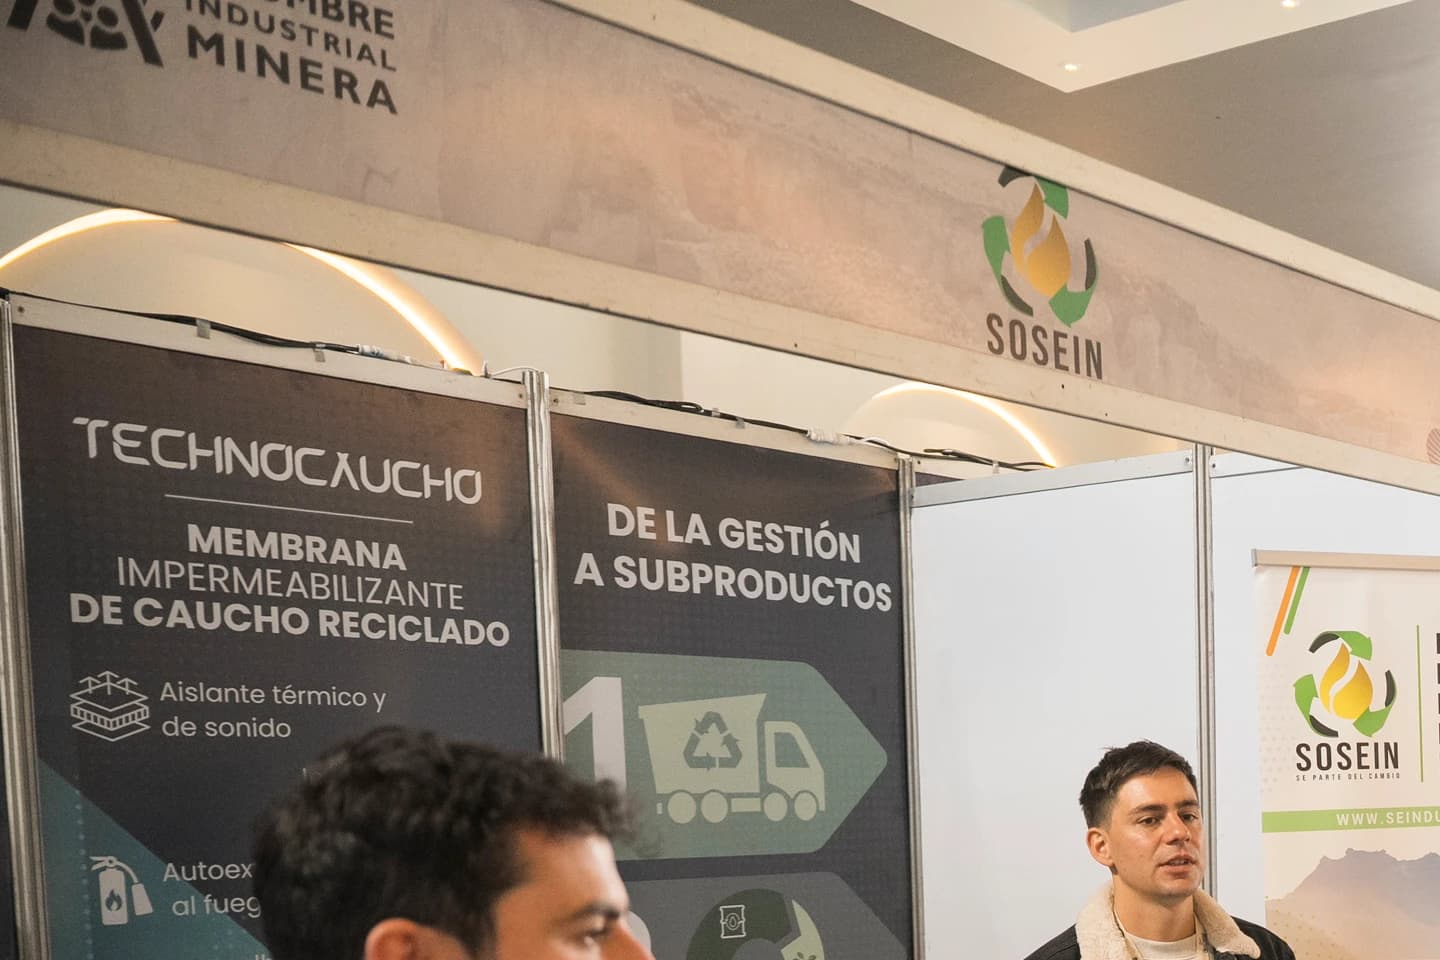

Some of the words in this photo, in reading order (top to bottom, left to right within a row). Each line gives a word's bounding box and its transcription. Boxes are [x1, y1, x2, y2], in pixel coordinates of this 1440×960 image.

[187, 24, 398, 115] MINERA
[986, 312, 1103, 380] SOSEIN
[72, 416, 483, 505] TECHNOCAUCHO
[187, 523, 407, 571] MEMBRANA
[606, 502, 657, 540] DE
[665, 509, 712, 547] LA
[718, 516, 861, 564] GESTIÓN
[117, 556, 465, 611] IMPERMEABILIZANTE
[573, 552, 605, 588] A
[613, 555, 893, 612] SUBPRODUCTOS
[69, 592, 124, 626] DE
[133, 598, 310, 636] CAUCHO
[319, 608, 511, 647] RECICLADO
[160, 680, 266, 706] Aislante
[272, 683, 368, 708] térmico
[372, 690, 387, 713] y
[161, 716, 198, 738] de
[204, 716, 293, 739] sonido
[1295, 741, 1399, 771] SOSEIN
[1313, 773, 1341, 781] PARTE
[163, 862, 255, 882] Autoex
[172, 895, 196, 916] al
[203, 893, 262, 918] fueg
